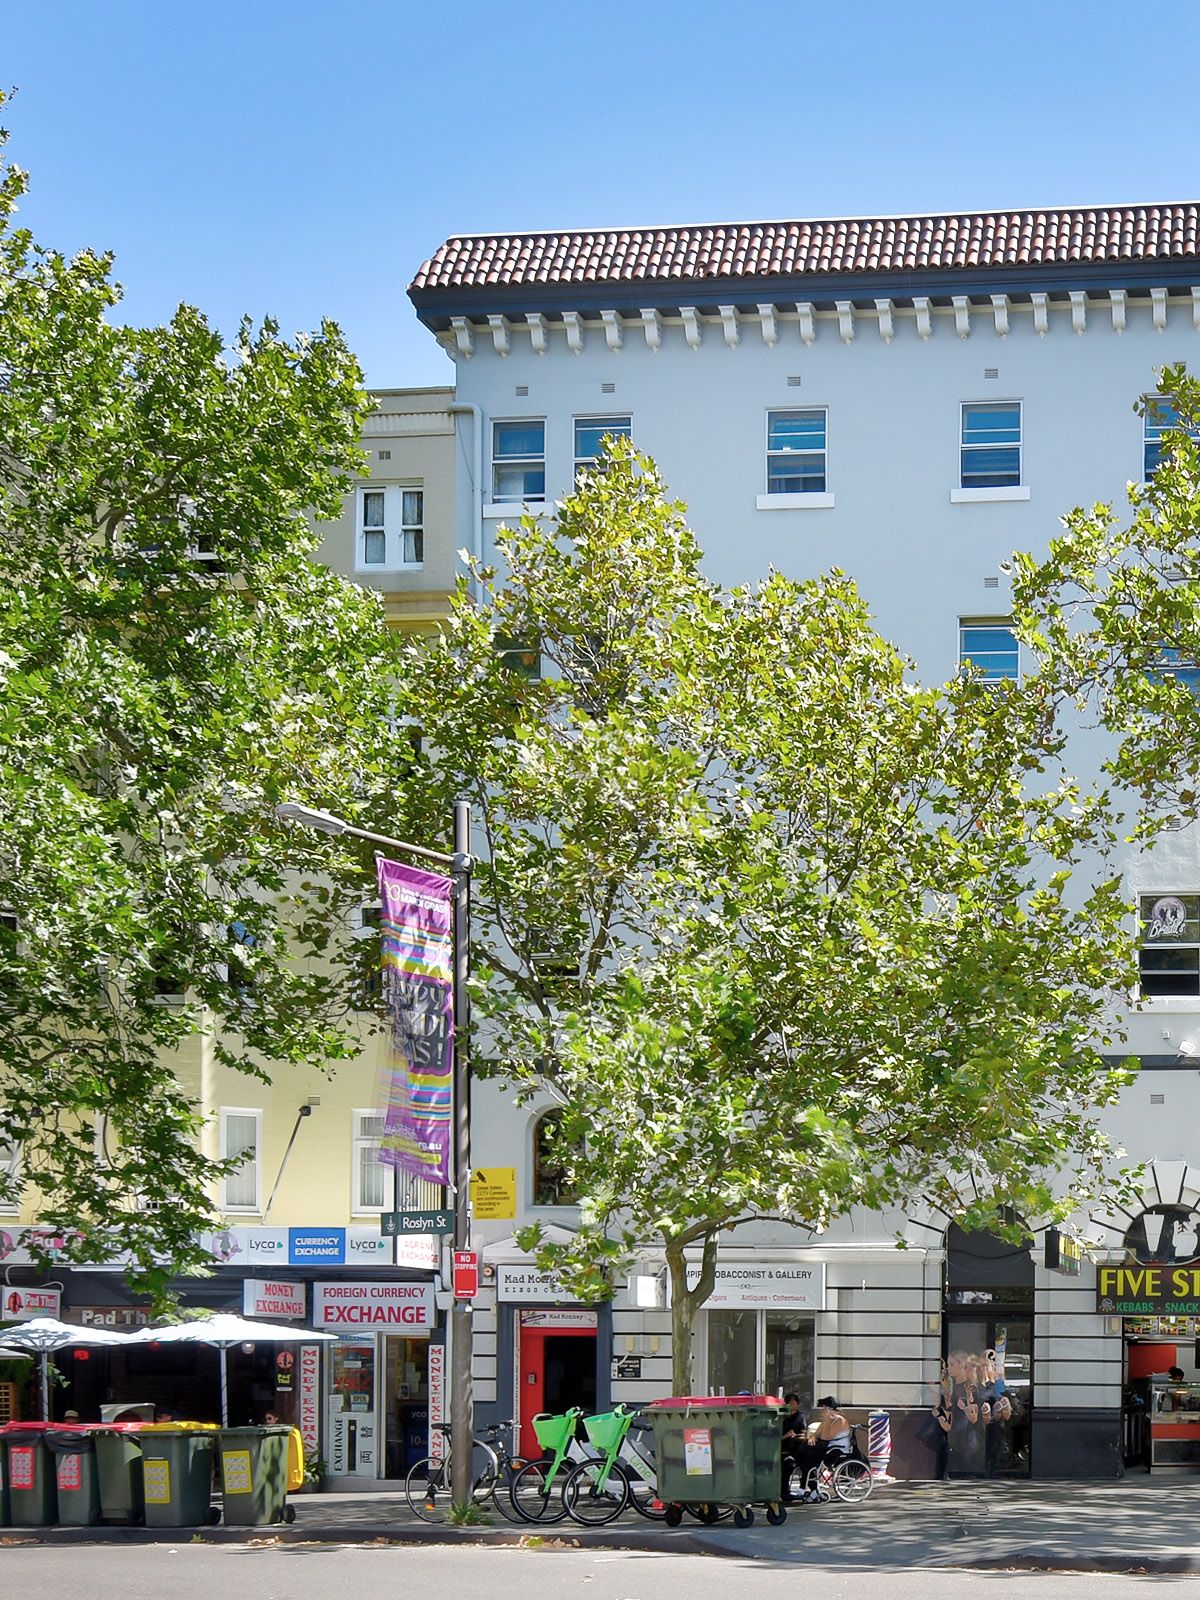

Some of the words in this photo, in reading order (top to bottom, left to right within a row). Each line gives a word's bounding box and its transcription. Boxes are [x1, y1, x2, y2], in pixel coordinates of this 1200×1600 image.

[402, 1217, 434, 1231] Roslyn
[436, 1215, 446, 1228] St
[250, 1239, 275, 1249] Lyca
[295, 1237, 339, 1246] CURRENCY
[350, 1239, 376, 1249] Lyca
[295, 1247, 339, 1256] EXCHANGE
[504, 1274, 525, 1284] Mad
[715, 1270, 766, 1279] OBACCONIST
[775, 1271, 812, 1279] GALLERY
[1100, 1269, 1162, 1297] FIVE
[264, 1284, 295, 1297] MONEY
[323, 1287, 367, 1298] FOREIGN
[370, 1287, 425, 1298] CURRENCY
[255, 1300, 303, 1315] EXCHANGE
[1116, 1302, 1154, 1312] KEBABS
[1164, 1302, 1199, 1313] SNACK
[82, 1310, 116, 1325] Pad
[323, 1305, 426, 1324] EXCHANGE
[303, 1350, 317, 1392] MONEY
[431, 1348, 443, 1390] MONEY
[334, 1418, 343, 1472] EXCHANGE
